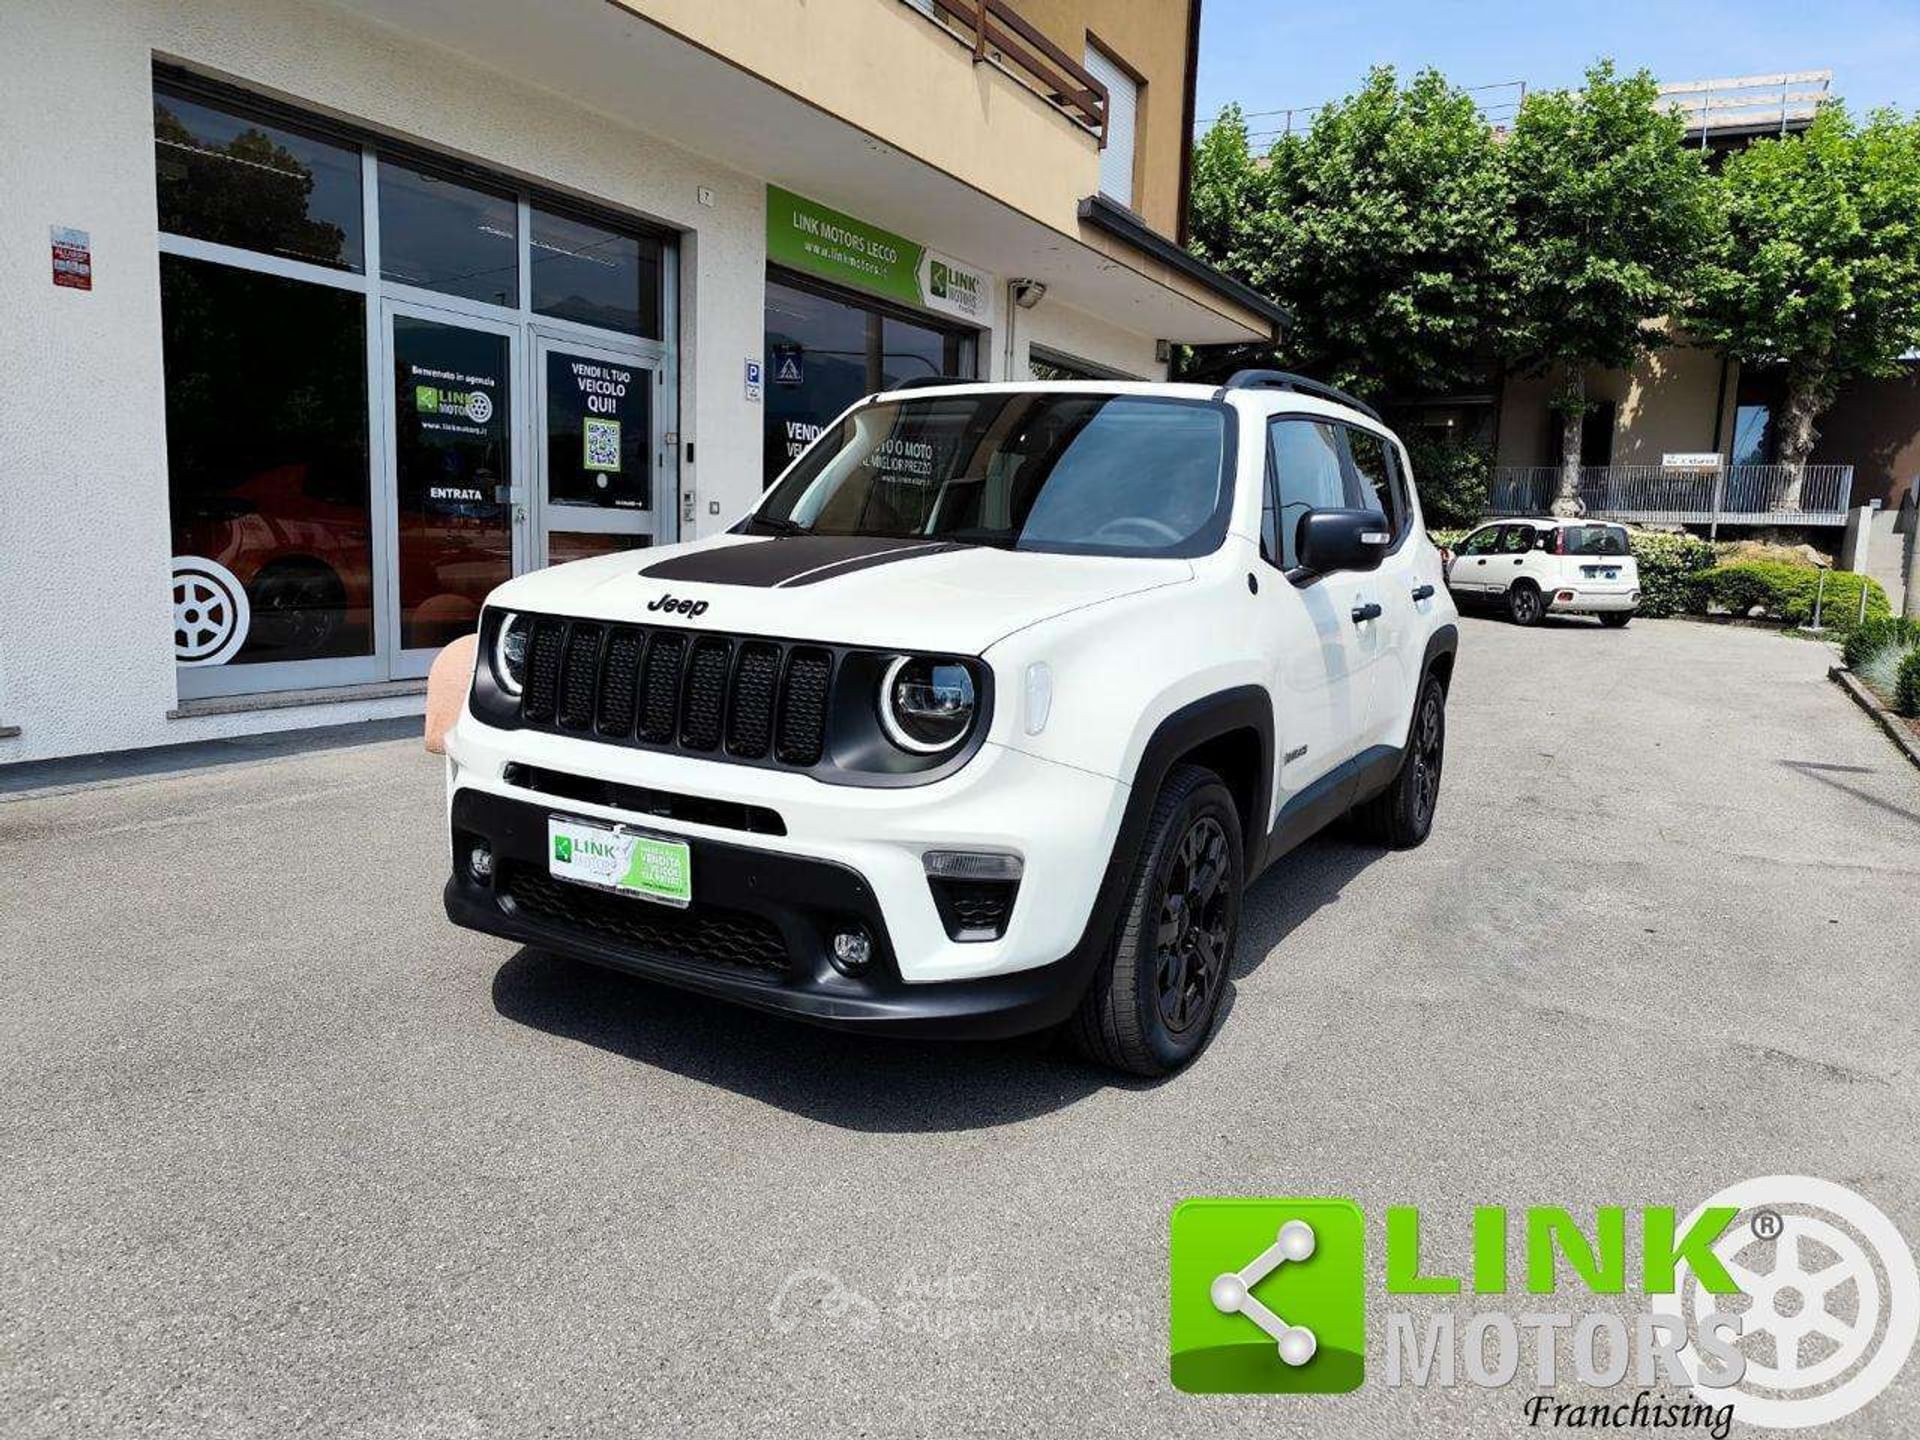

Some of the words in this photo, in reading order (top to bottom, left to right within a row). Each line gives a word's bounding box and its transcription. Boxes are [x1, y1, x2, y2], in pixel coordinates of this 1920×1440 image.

[793, 210, 819, 236] LINK
[819, 222, 865, 252] MOTORS
[866, 241, 898, 264] LECCO
[948, 268, 976, 294] LINK
[412, 365, 455, 381] Benvenuto
[456, 372, 464, 381] in
[571, 363, 601, 379] VENDI
[602, 368, 610, 380] IL
[610, 369, 631, 383] TUO
[749, 366, 758, 381] P
[577, 377, 626, 397] VEICOLO
[587, 395, 617, 414] QUI!
[905, 441, 933, 460] MOTO
[430, 487, 482, 500] ENTRATA
[647, 593, 709, 619] Jeep
[574, 838, 616, 860] LINK
